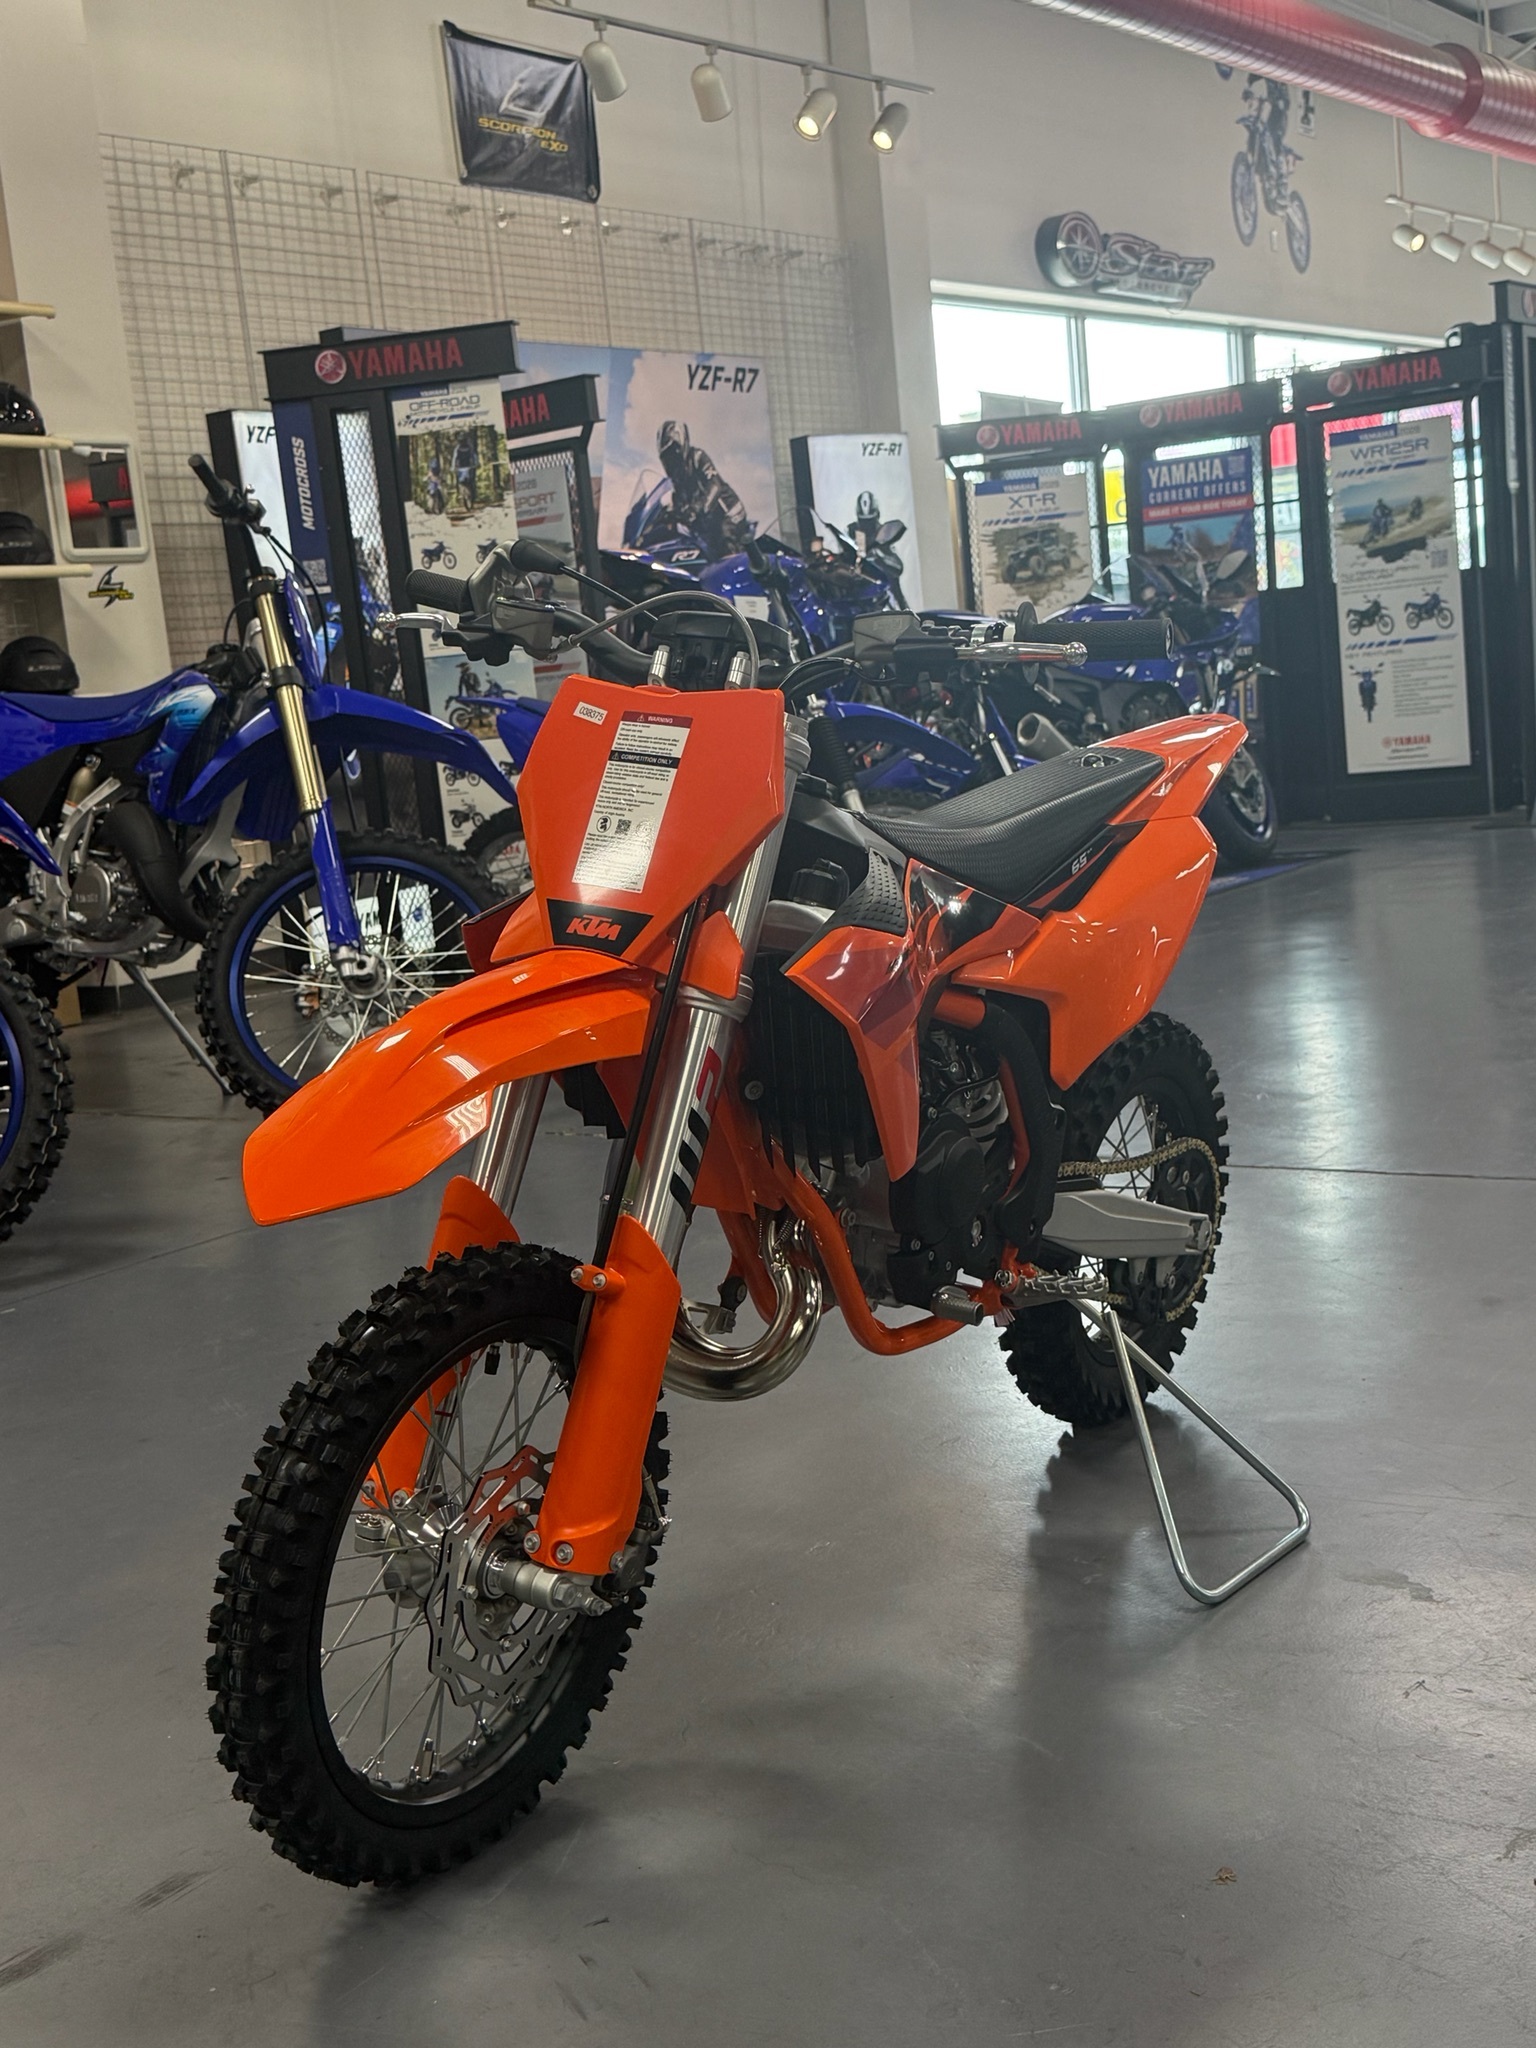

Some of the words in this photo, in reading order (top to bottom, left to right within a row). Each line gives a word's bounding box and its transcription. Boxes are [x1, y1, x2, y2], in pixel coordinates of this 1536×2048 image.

[478, 117, 556, 139] SCORPION
[347, 338, 464, 379] YAMAHA
[687, 364, 760, 393] YZF-R7
[1353, 356, 1442, 392] YAMAHA
[409, 395, 480, 411] OFF-ROAD
[1162, 391, 1243, 423] YAMAHA
[1000, 418, 1082, 446] YAMAHA
[861, 443, 903, 457] YZF-R1
[1350, 437, 1429, 460] WR125R
[291, 436, 316, 530] MOTOCROSS
[1148, 458, 1224, 488] YAMAHA
[1009, 492, 1056, 509] XT-R
[1149, 486, 1199, 504] CURRENT
[1203, 480, 1247, 497] OFFERS
[579, 706, 604, 721] 038375
[647, 715, 673, 724] WARNING
[1393, 734, 1431, 747] YAMAHA
[621, 753, 657, 764] COMPETITION
[657, 757, 673, 765] ONLY
[1071, 851, 1087, 875] 65
[566, 914, 622, 941] KTM
